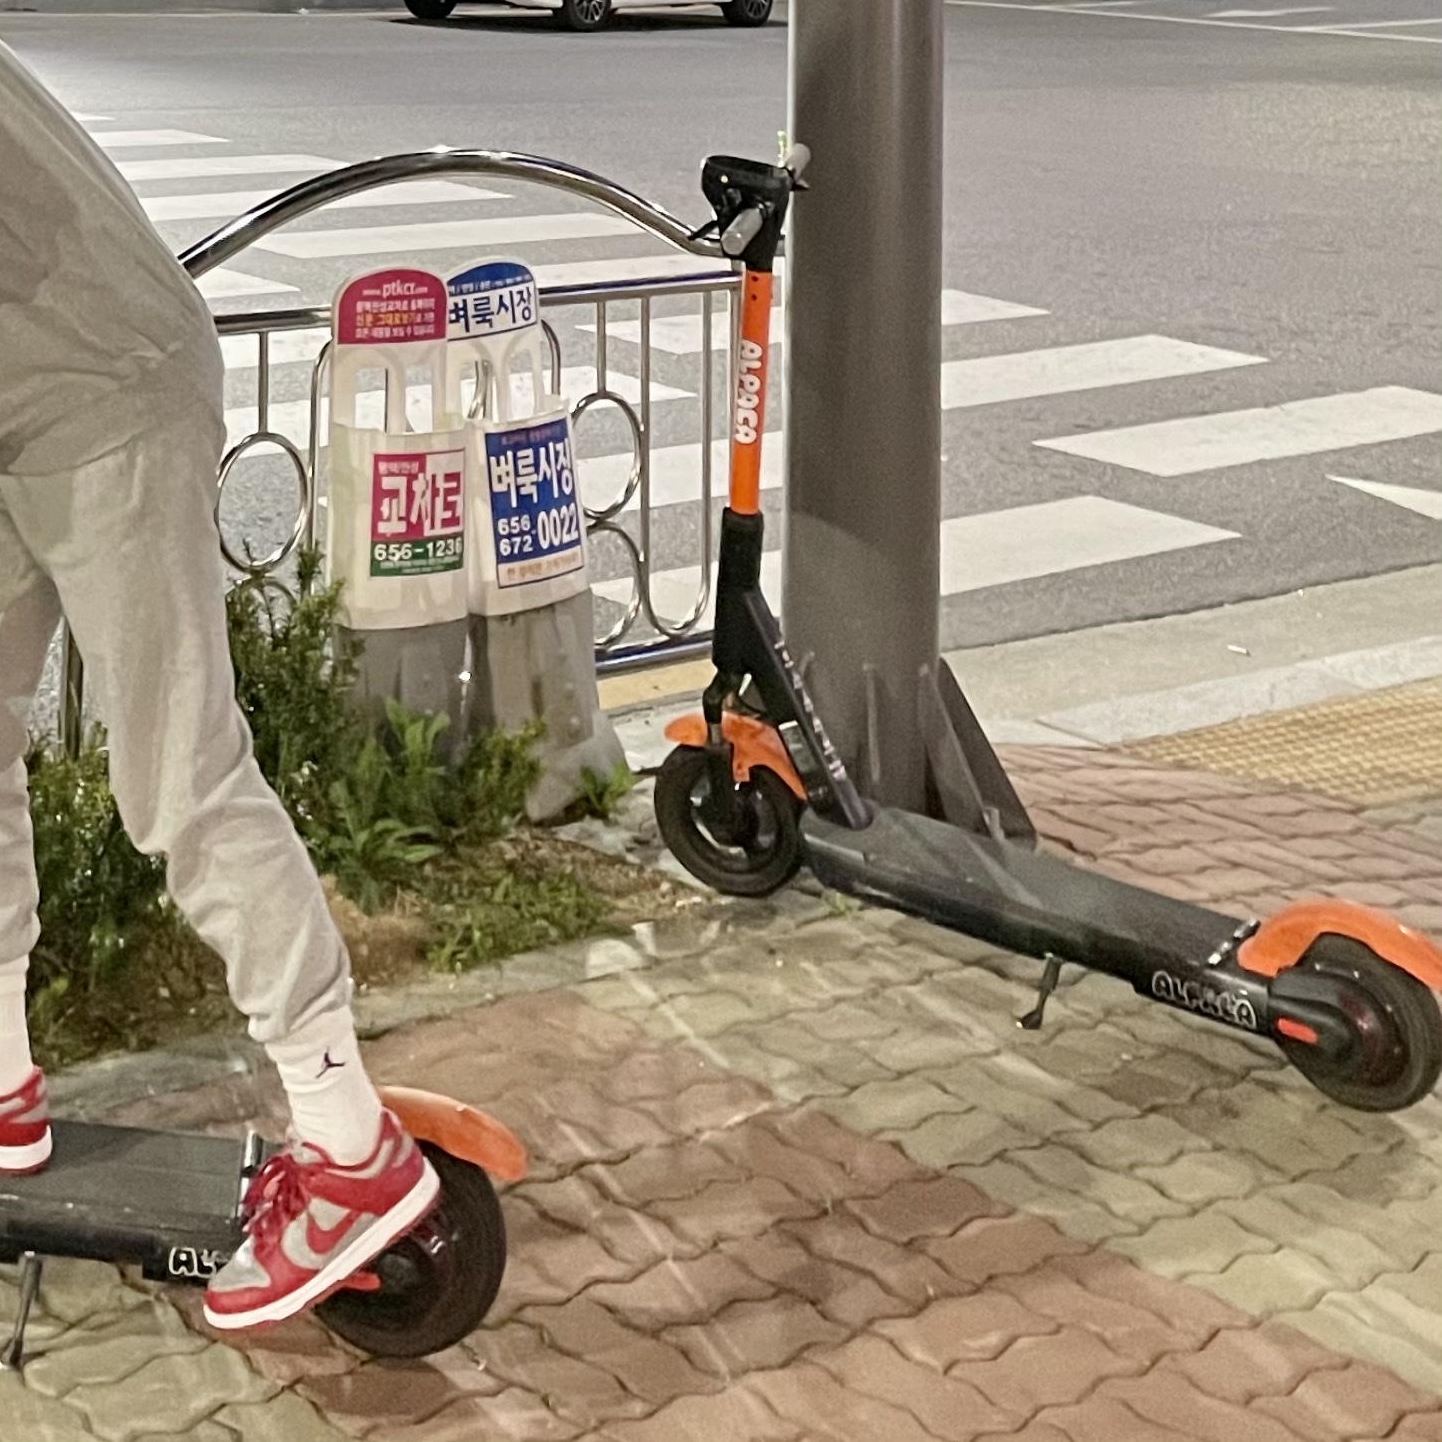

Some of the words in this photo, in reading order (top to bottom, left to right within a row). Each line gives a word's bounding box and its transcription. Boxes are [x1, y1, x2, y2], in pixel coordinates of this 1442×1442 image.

[449, 286, 532, 333] 벼룩시장
[735, 338, 763, 445] ALPACA
[489, 437, 573, 508] 벼룩시장
[377, 472, 462, 537] 교차로
[497, 514, 531, 536] 656
[374, 537, 463, 561] 656-1236
[499, 534, 533, 557] 672
